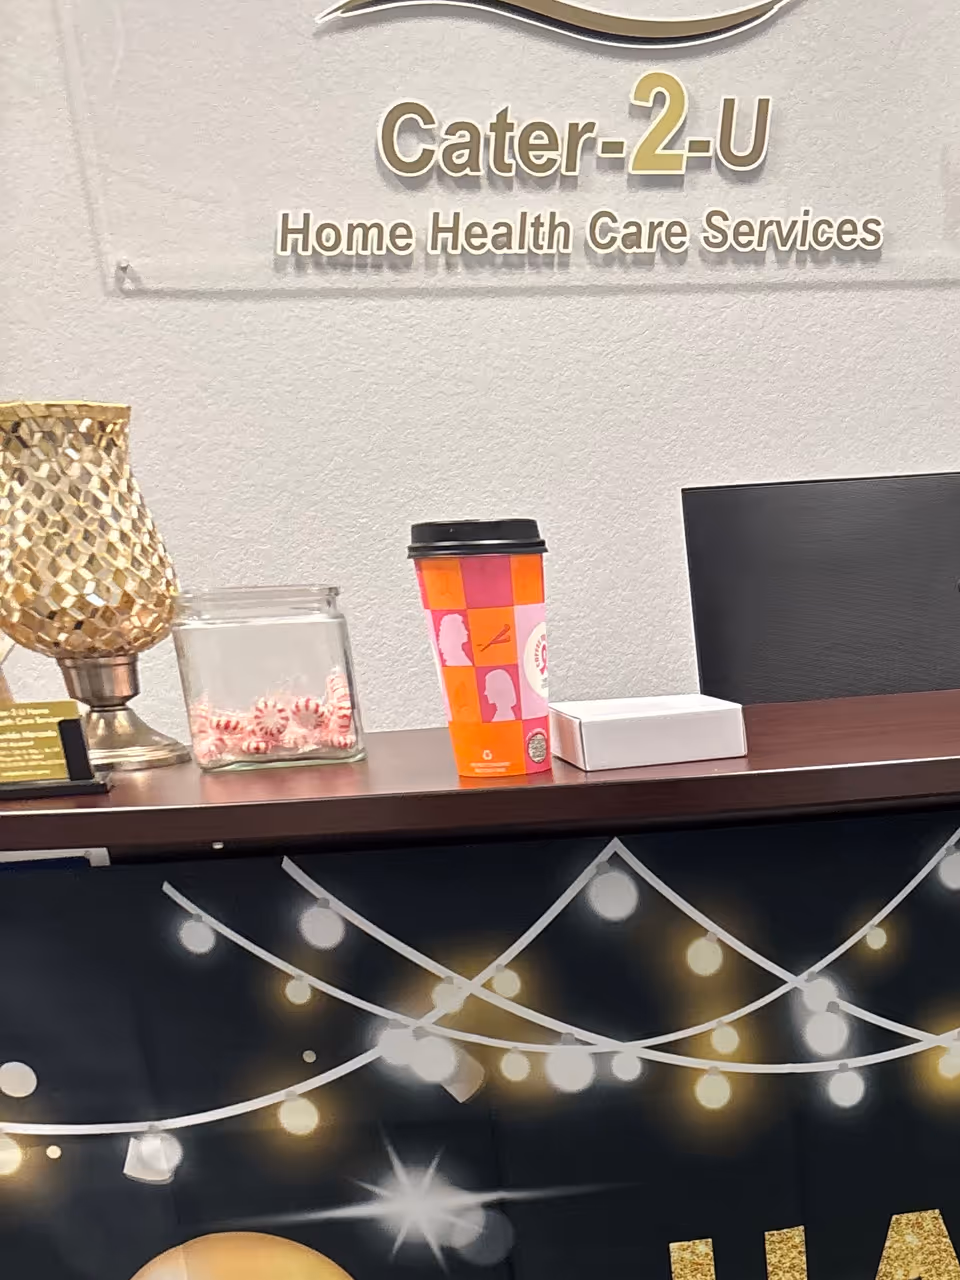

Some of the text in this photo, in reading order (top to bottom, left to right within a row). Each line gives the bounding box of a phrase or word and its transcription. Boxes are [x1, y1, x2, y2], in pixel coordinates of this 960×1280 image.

[378, 71, 772, 178] Cater-2-U
[277, 205, 886, 257] Home Health Care Services
